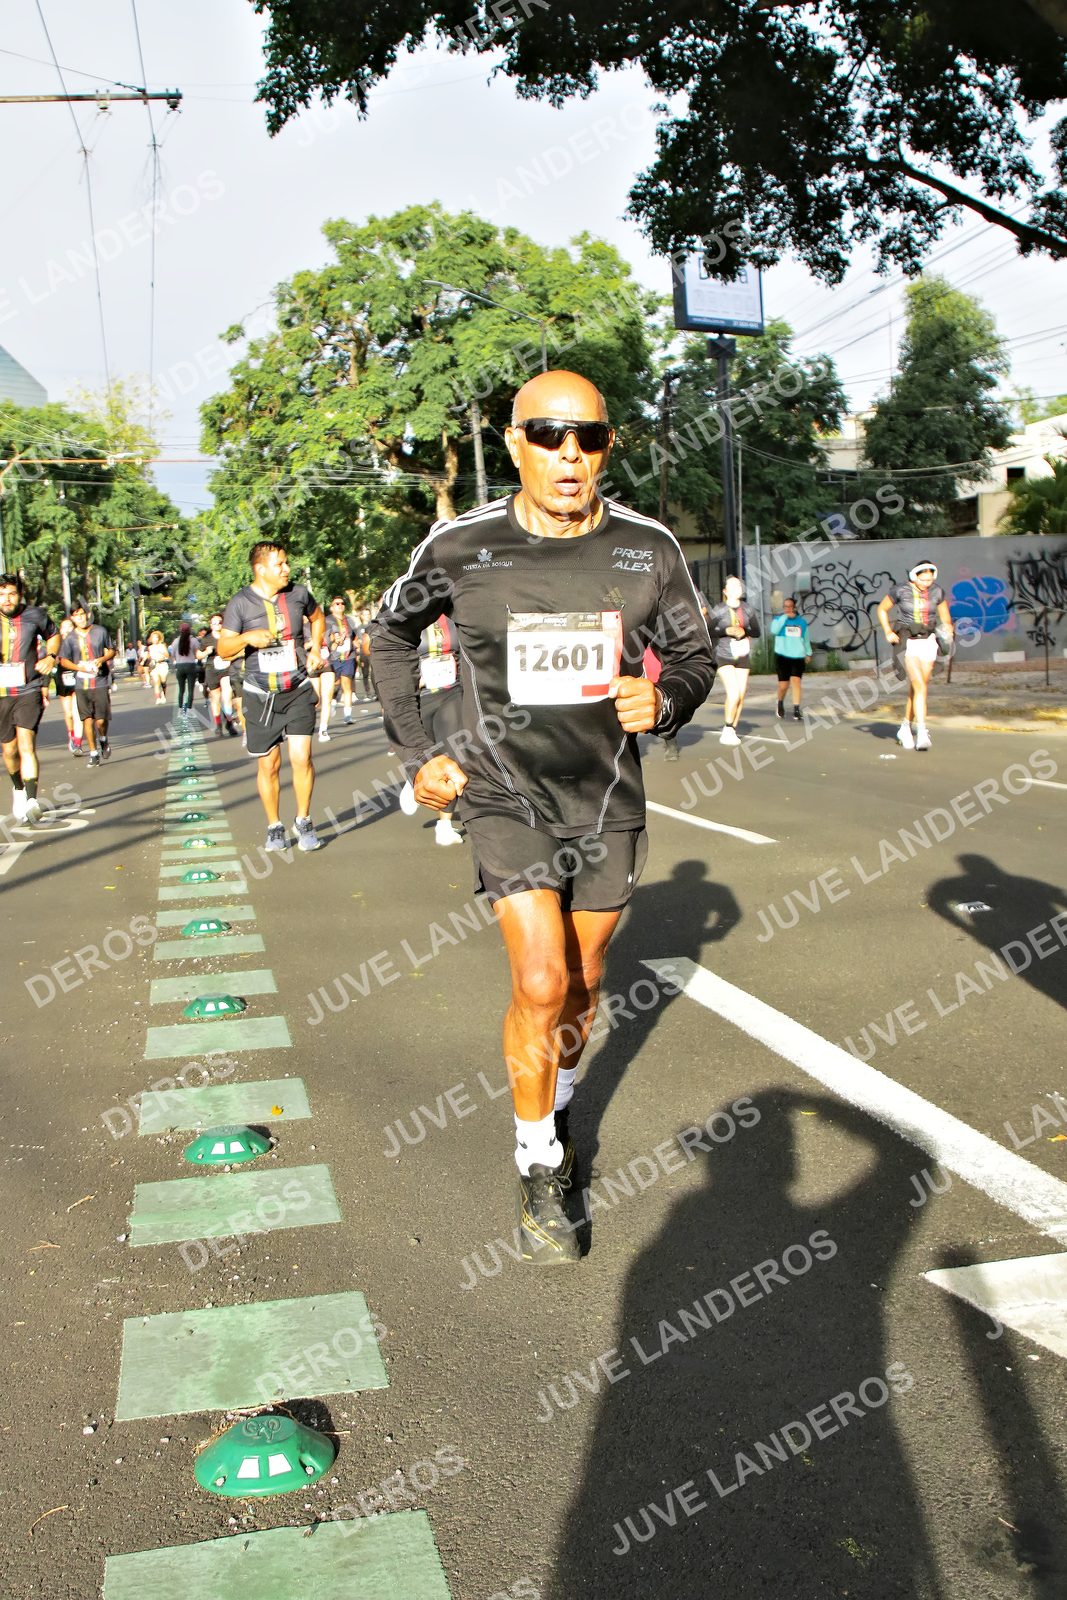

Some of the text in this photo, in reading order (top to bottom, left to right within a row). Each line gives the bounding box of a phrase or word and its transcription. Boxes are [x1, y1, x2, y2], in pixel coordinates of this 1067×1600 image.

[612, 547, 654, 560] PROF.
[612, 560, 654, 572] ALEX
[811, 560, 852, 576] TOY
[514, 642, 604, 672] 12601
